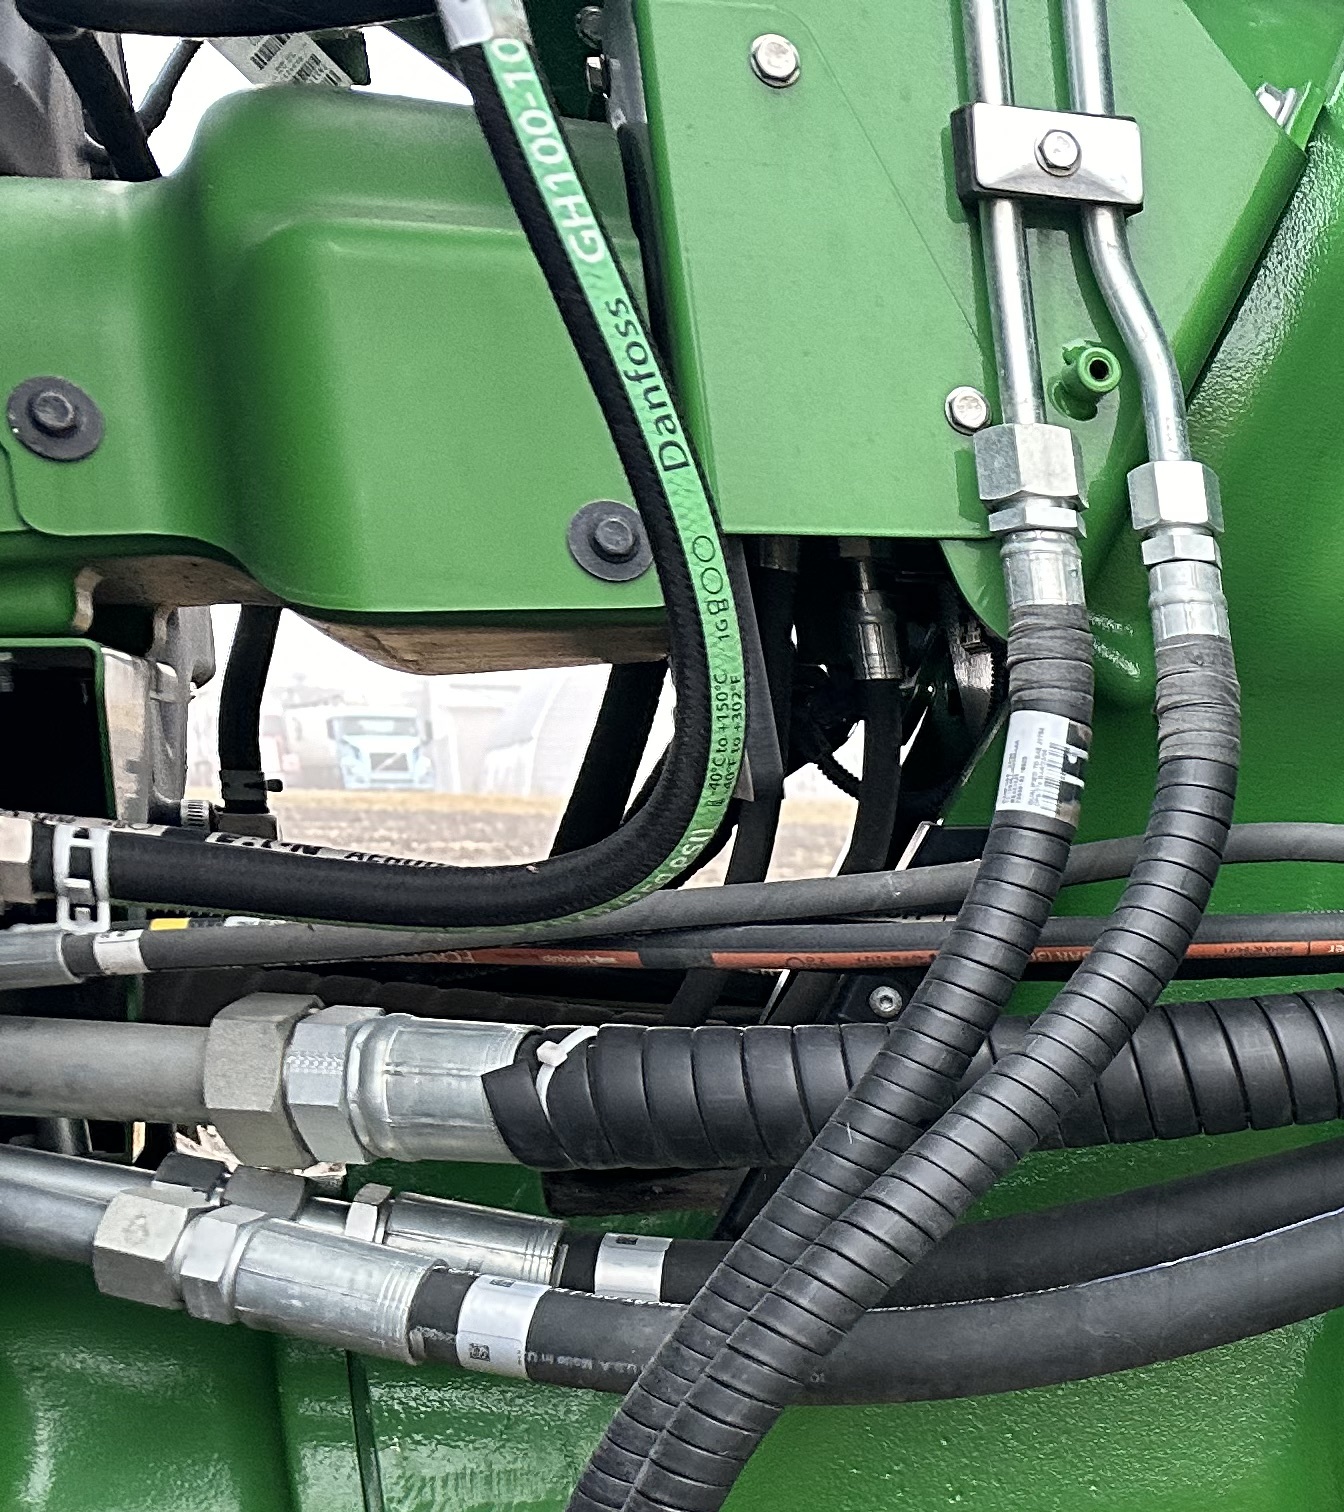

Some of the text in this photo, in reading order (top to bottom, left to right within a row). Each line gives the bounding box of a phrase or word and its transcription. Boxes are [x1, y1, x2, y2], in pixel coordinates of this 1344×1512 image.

[491, 38, 691, 471] Danfoss GH100-10
[713, 672, 730, 732] +150°C
[717, 737, 729, 754] to
[731, 737, 743, 753] to
